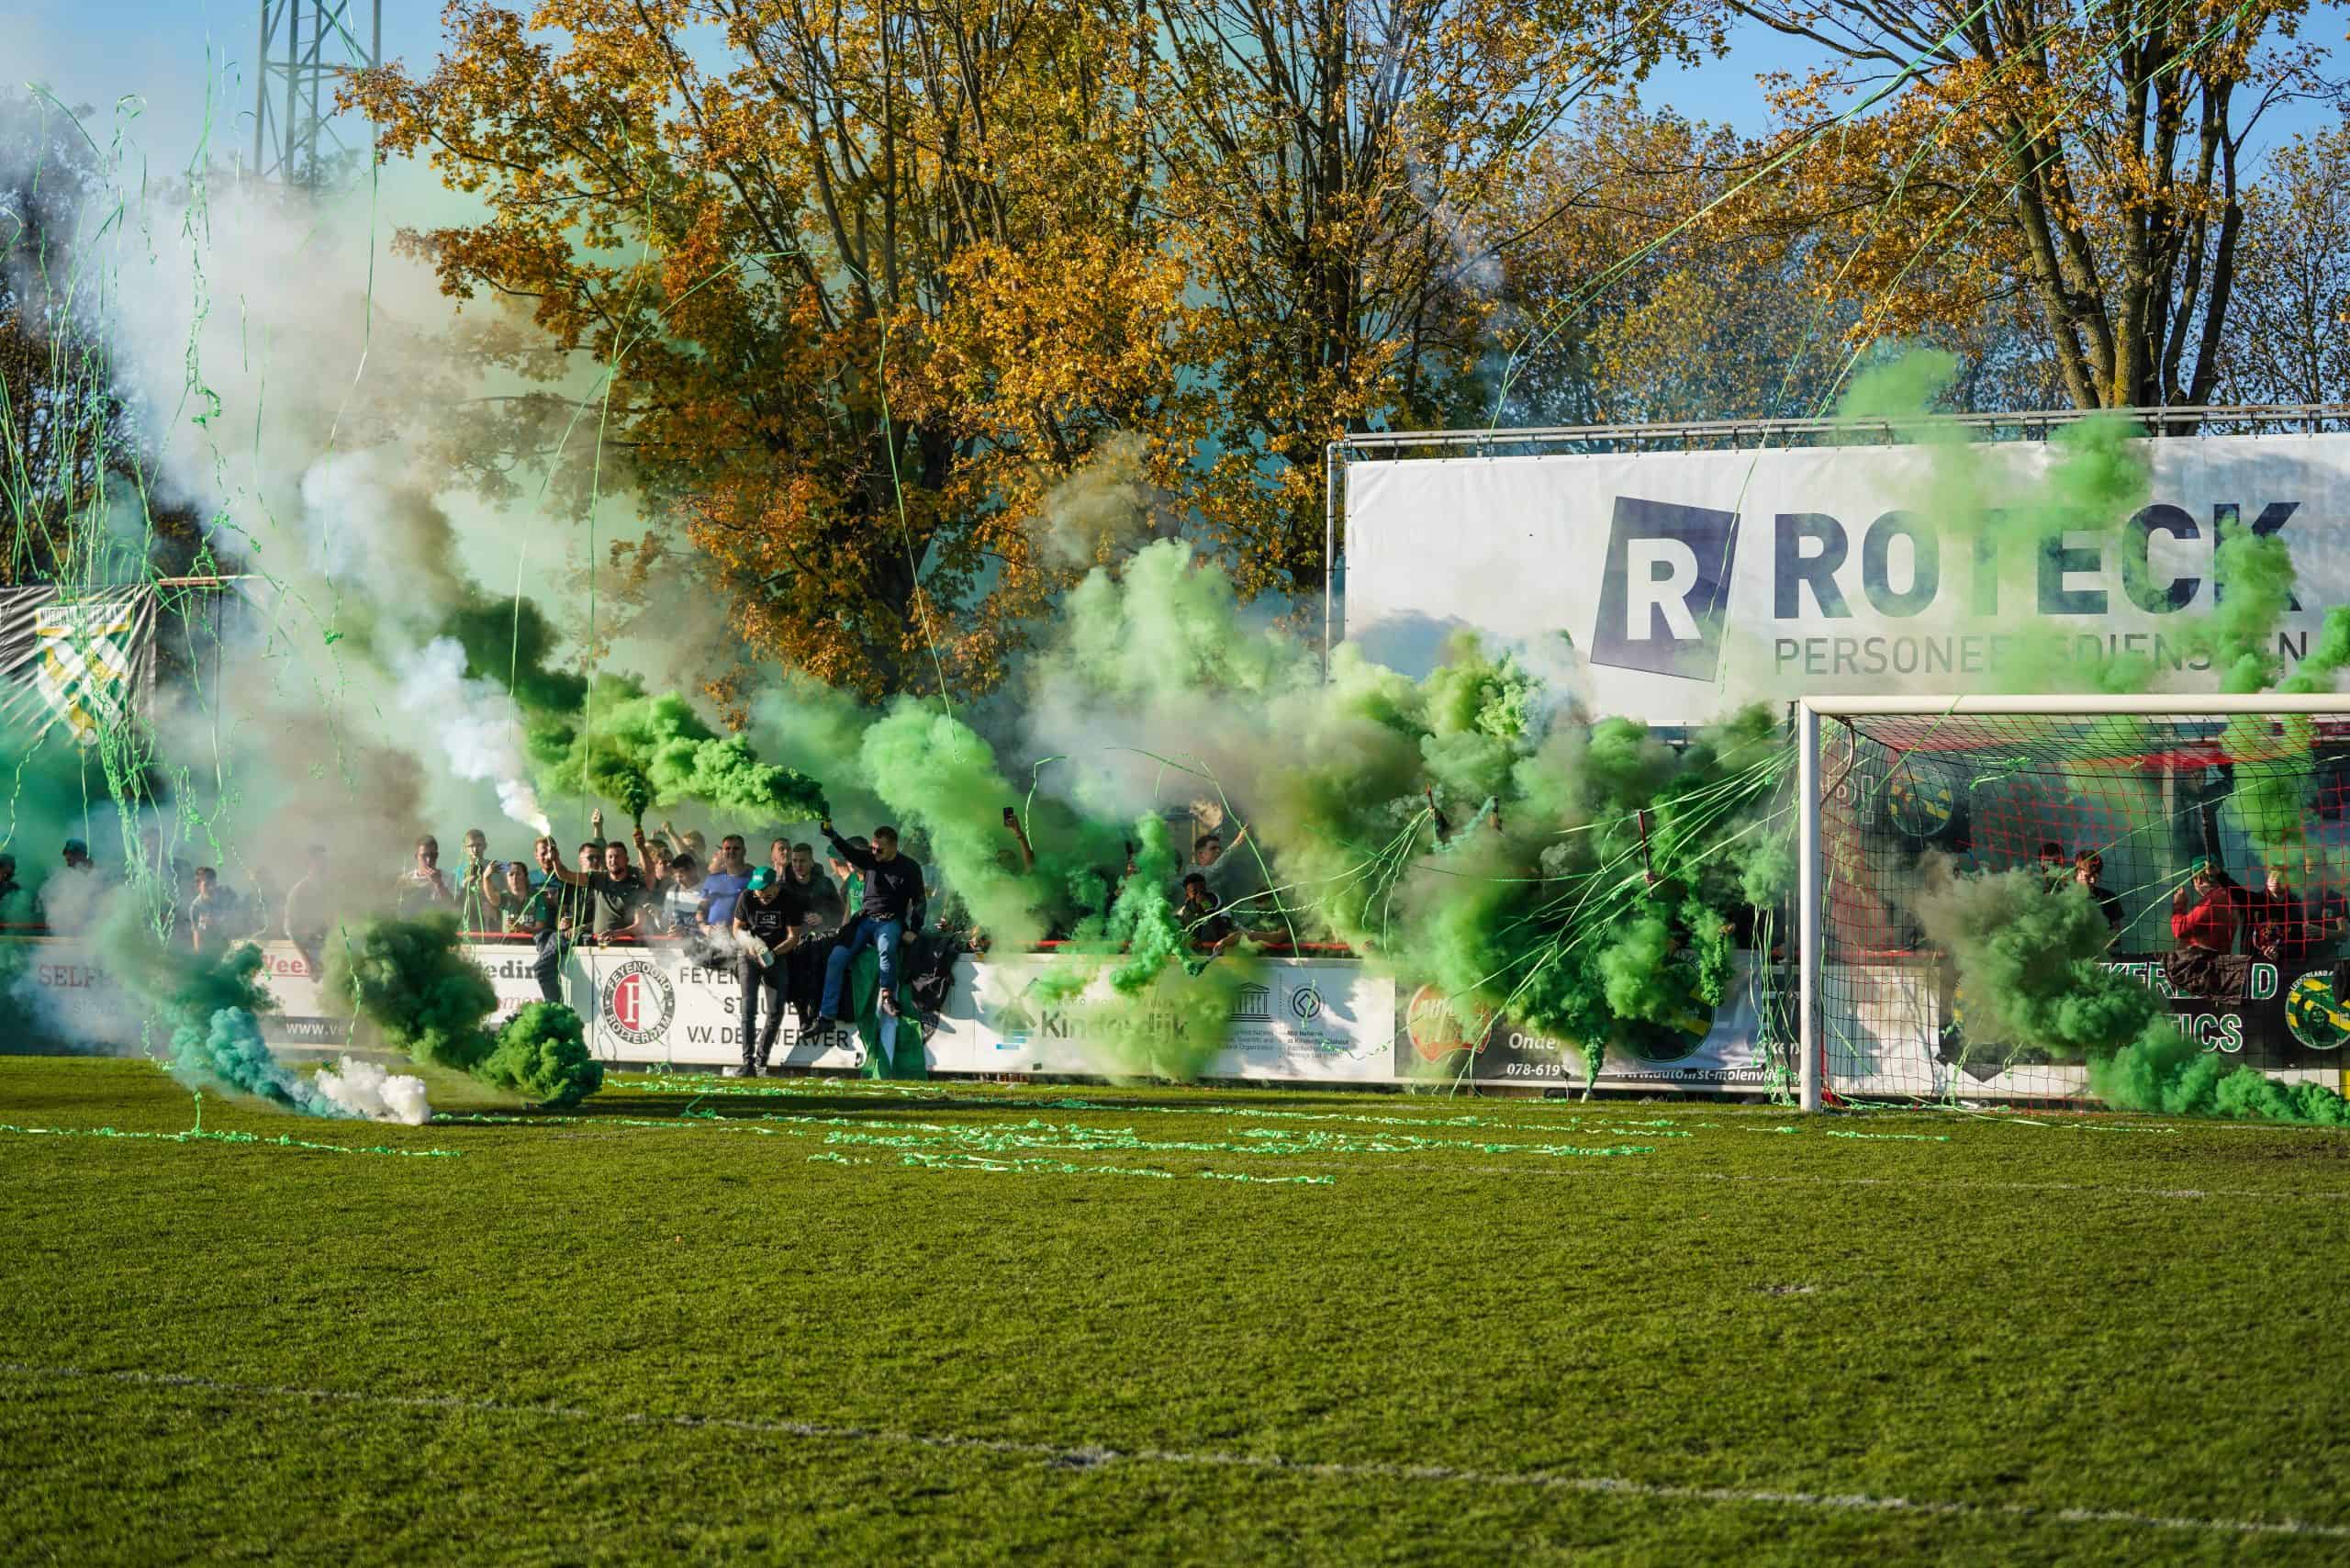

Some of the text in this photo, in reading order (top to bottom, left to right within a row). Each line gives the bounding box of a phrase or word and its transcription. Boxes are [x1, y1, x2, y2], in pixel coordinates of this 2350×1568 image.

[1627, 538, 1700, 641] R
[1774, 630, 2308, 677] PERSONEESDIENSN
[607, 961, 672, 991] FEYENOORD
[679, 967, 742, 985] FEYEN
[607, 1013, 671, 1044] ROTTERDAM
[687, 1025, 715, 1044] V.V.
[1508, 1032, 1557, 1050] Onde
[1506, 1062, 1564, 1077] 078-619
